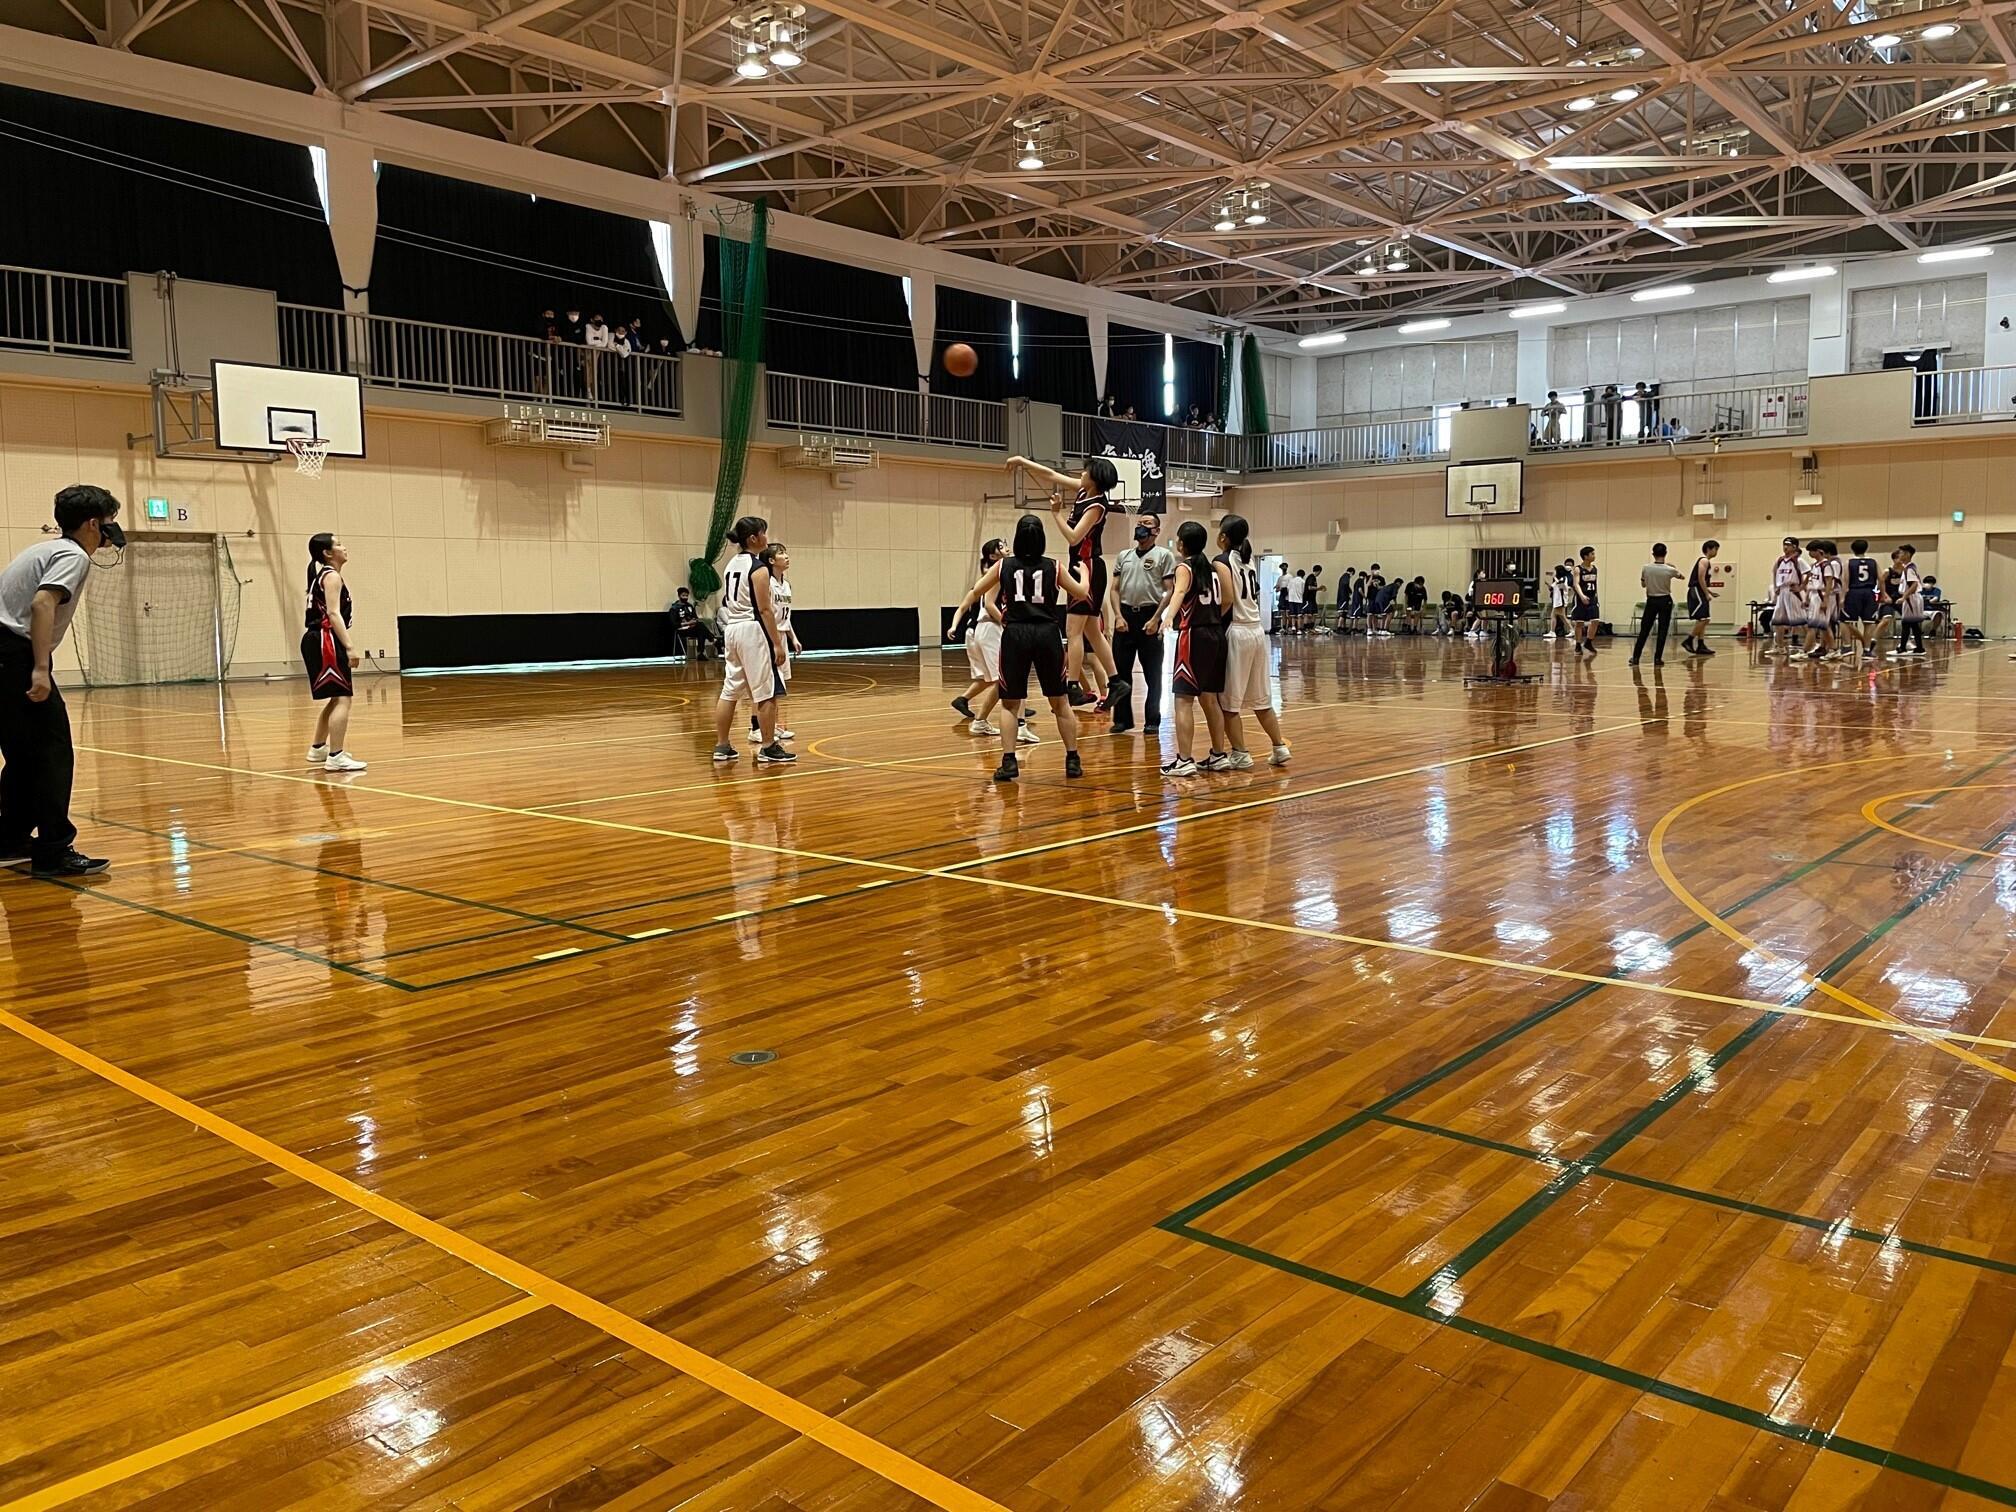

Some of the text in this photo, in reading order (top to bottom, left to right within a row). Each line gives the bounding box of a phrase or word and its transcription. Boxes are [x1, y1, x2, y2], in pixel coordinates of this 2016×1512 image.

[177, 508, 188, 521] B
[1858, 565, 1869, 582] 5
[725, 571, 742, 602] 17
[1013, 569, 1045, 604] 11
[1512, 593, 1520, 605] 0
